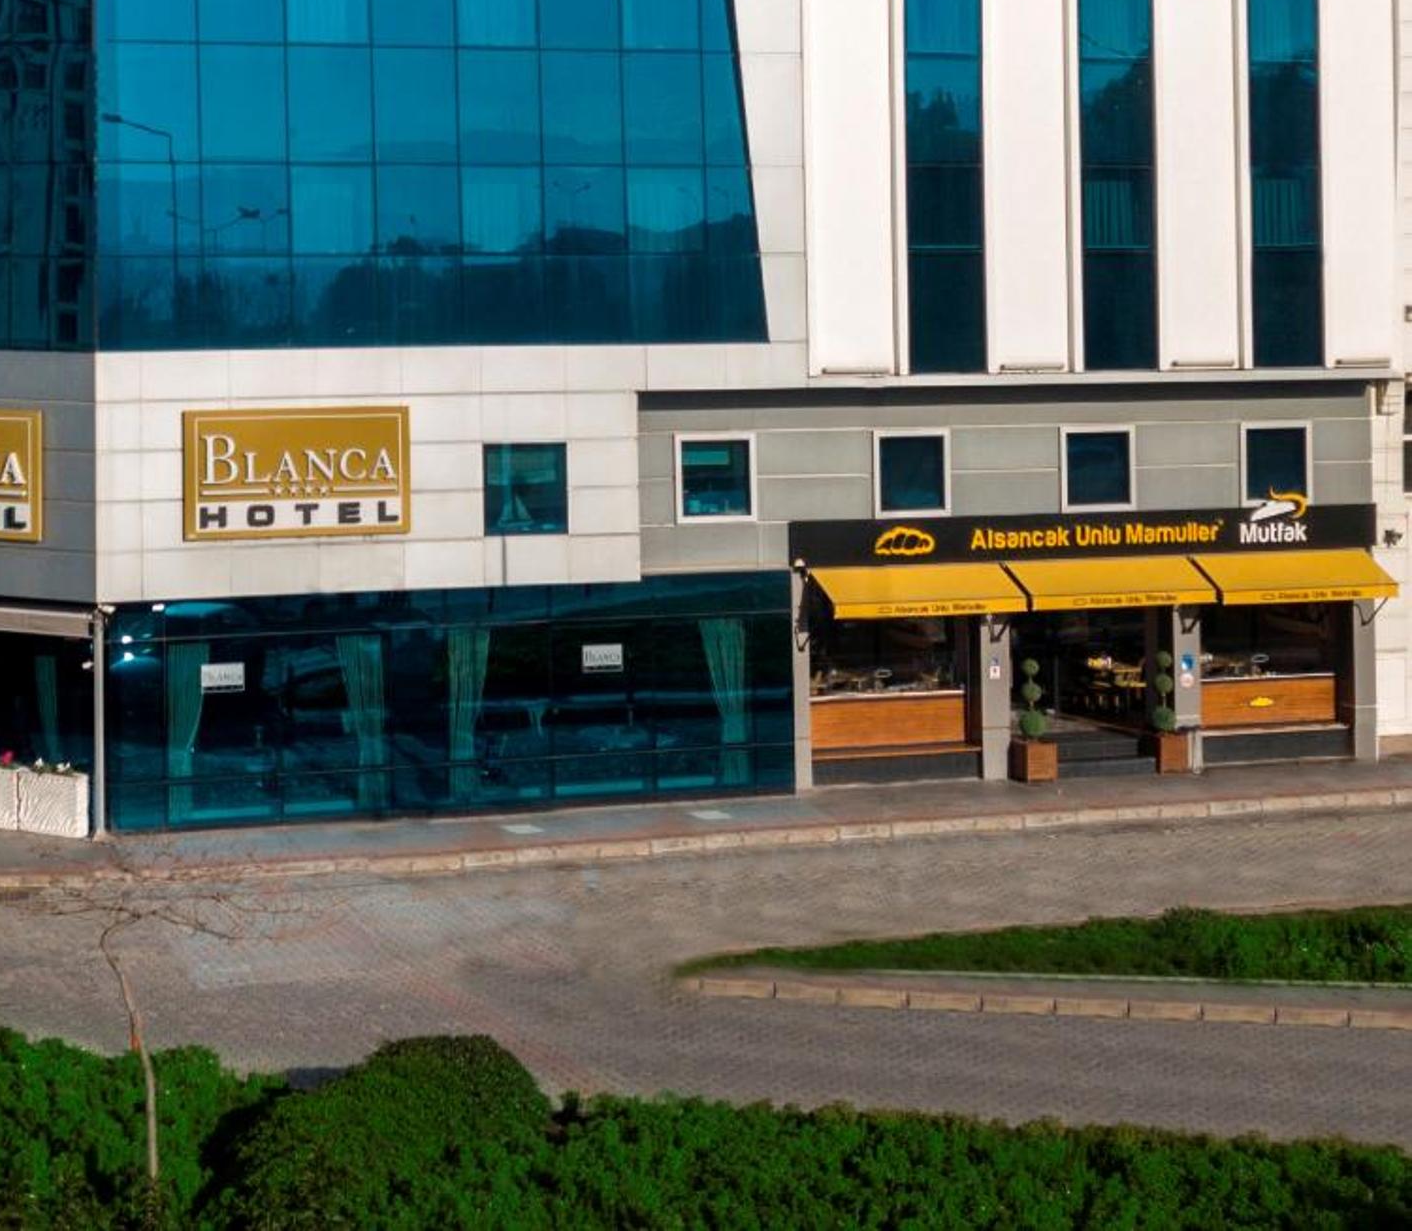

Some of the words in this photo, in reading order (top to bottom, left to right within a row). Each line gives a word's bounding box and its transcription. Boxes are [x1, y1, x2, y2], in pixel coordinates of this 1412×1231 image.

[200, 433, 397, 485] BLANCA
[198, 500, 399, 529] HOTEL
[970, 526, 1071, 550] Alsancak
[1075, 524, 1122, 546] Unlu
[1239, 521, 1308, 543] Mutfak
